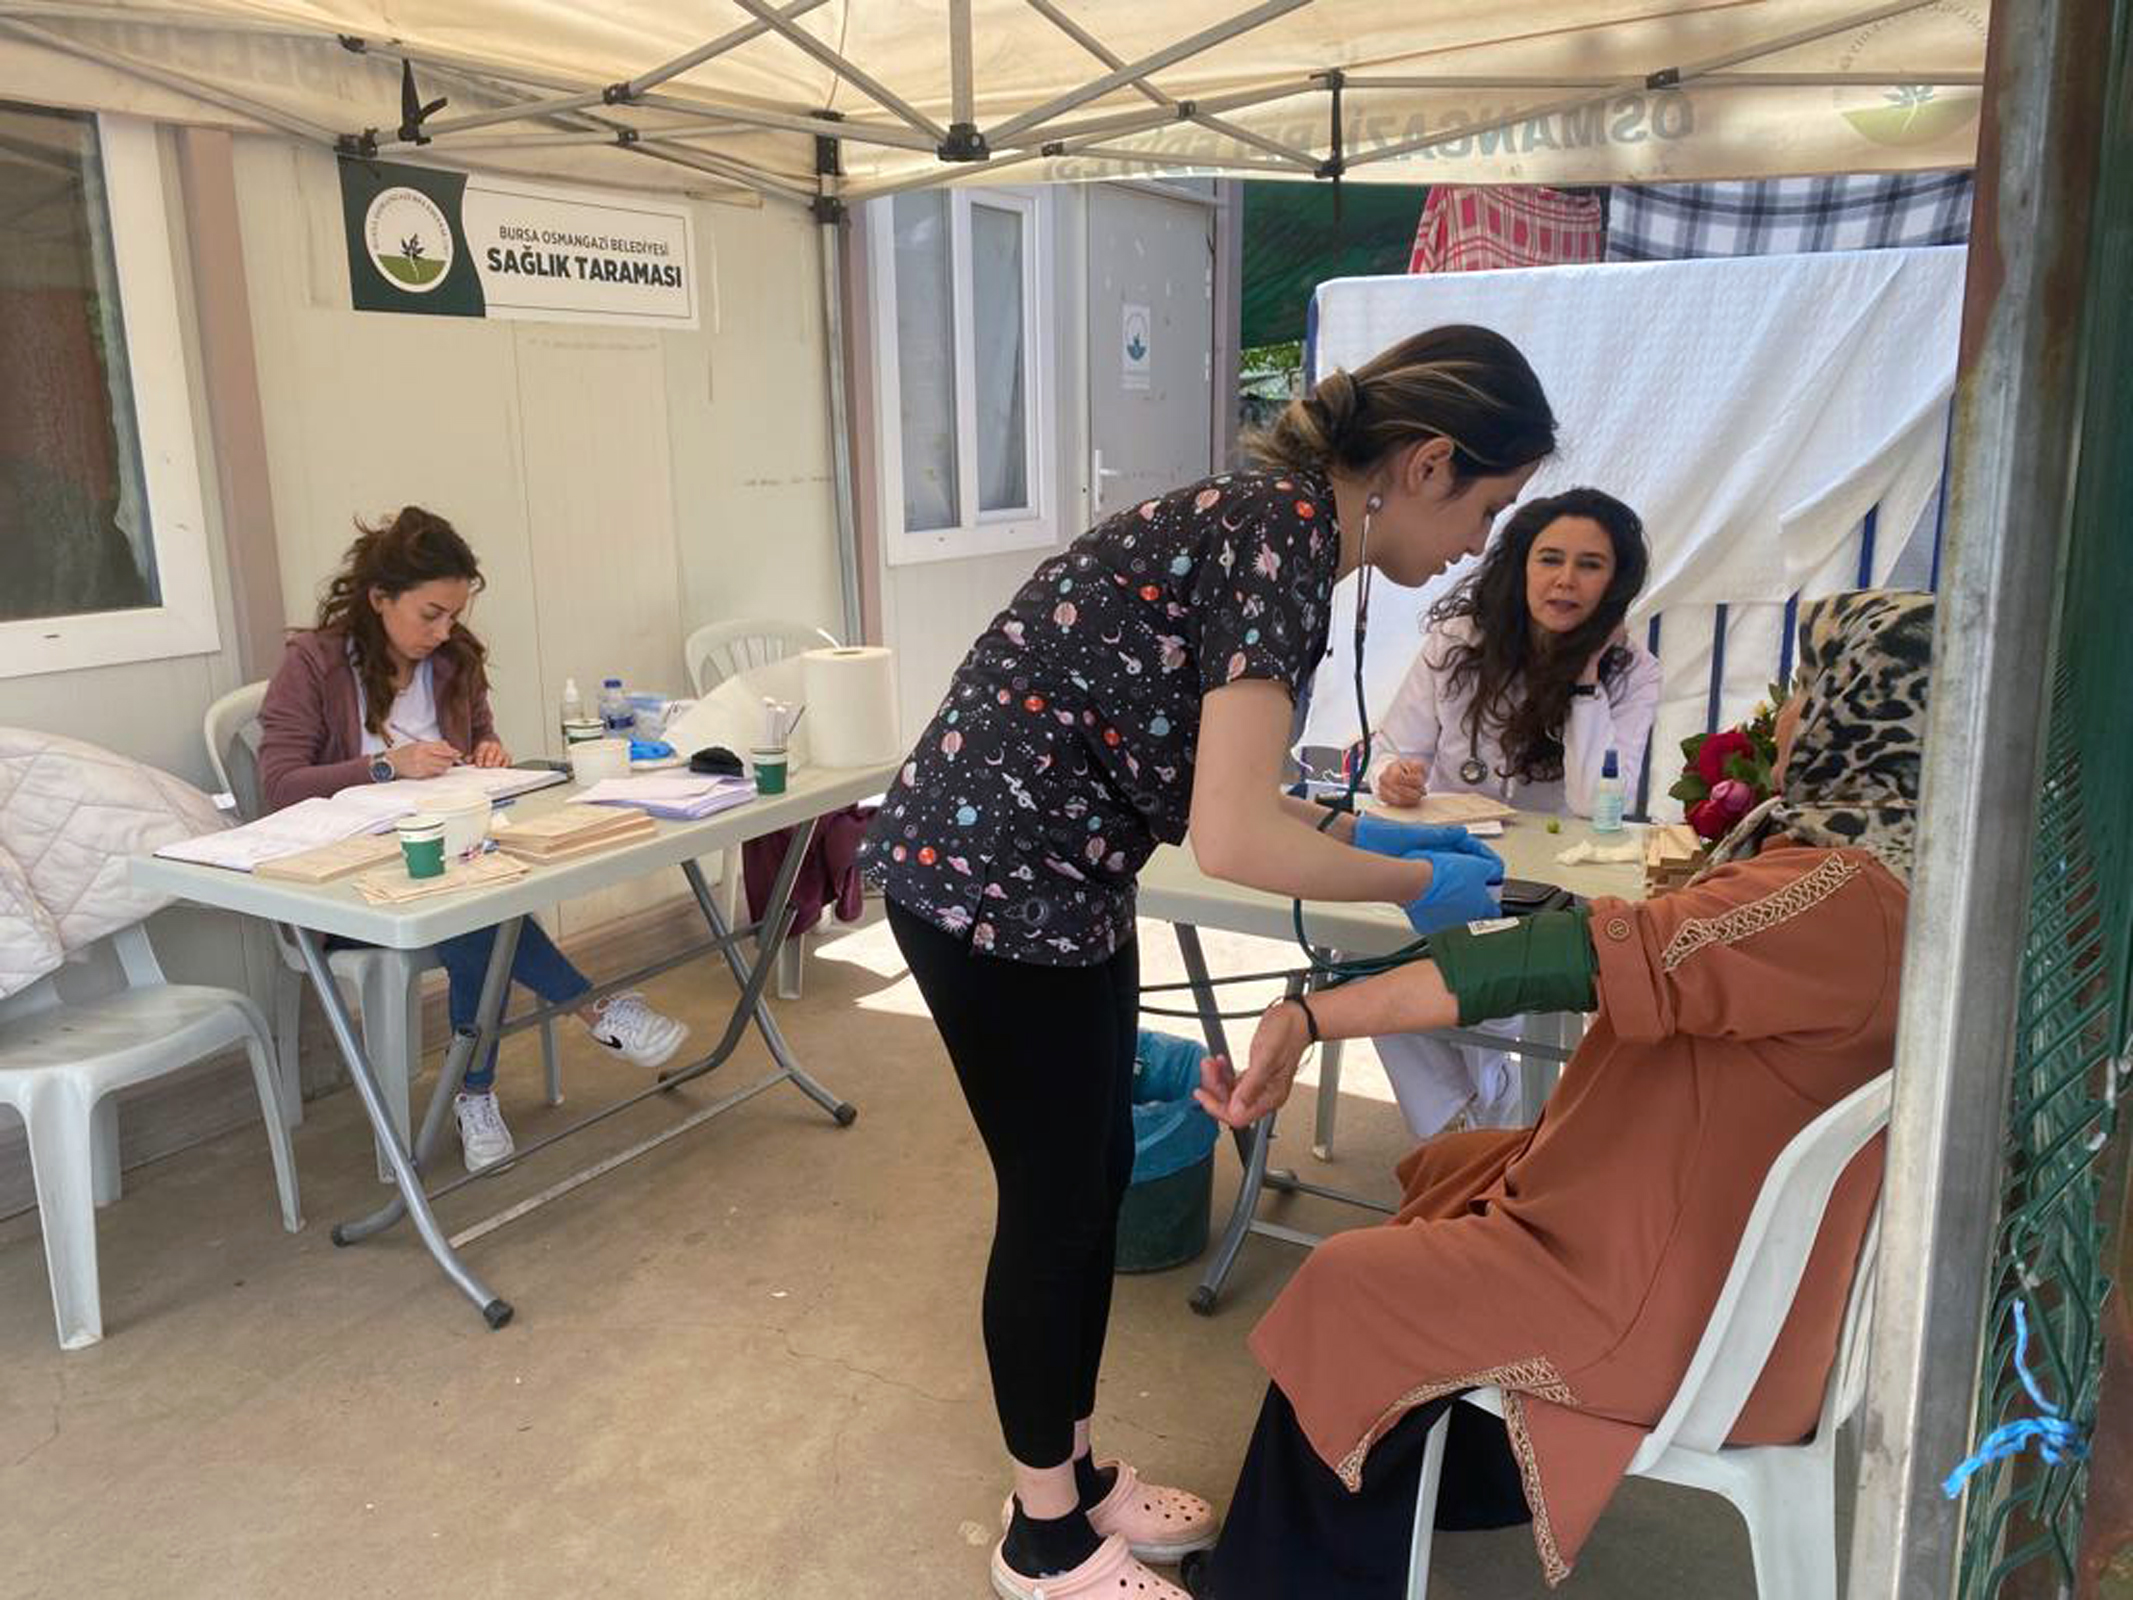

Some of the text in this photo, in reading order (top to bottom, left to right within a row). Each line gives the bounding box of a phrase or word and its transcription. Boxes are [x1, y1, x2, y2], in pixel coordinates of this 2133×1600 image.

[499, 225, 669, 257] BURSA OSMANGAZİ BELEDİYESİ
[486, 244, 682, 288] SAĞLIK TARAMASI
